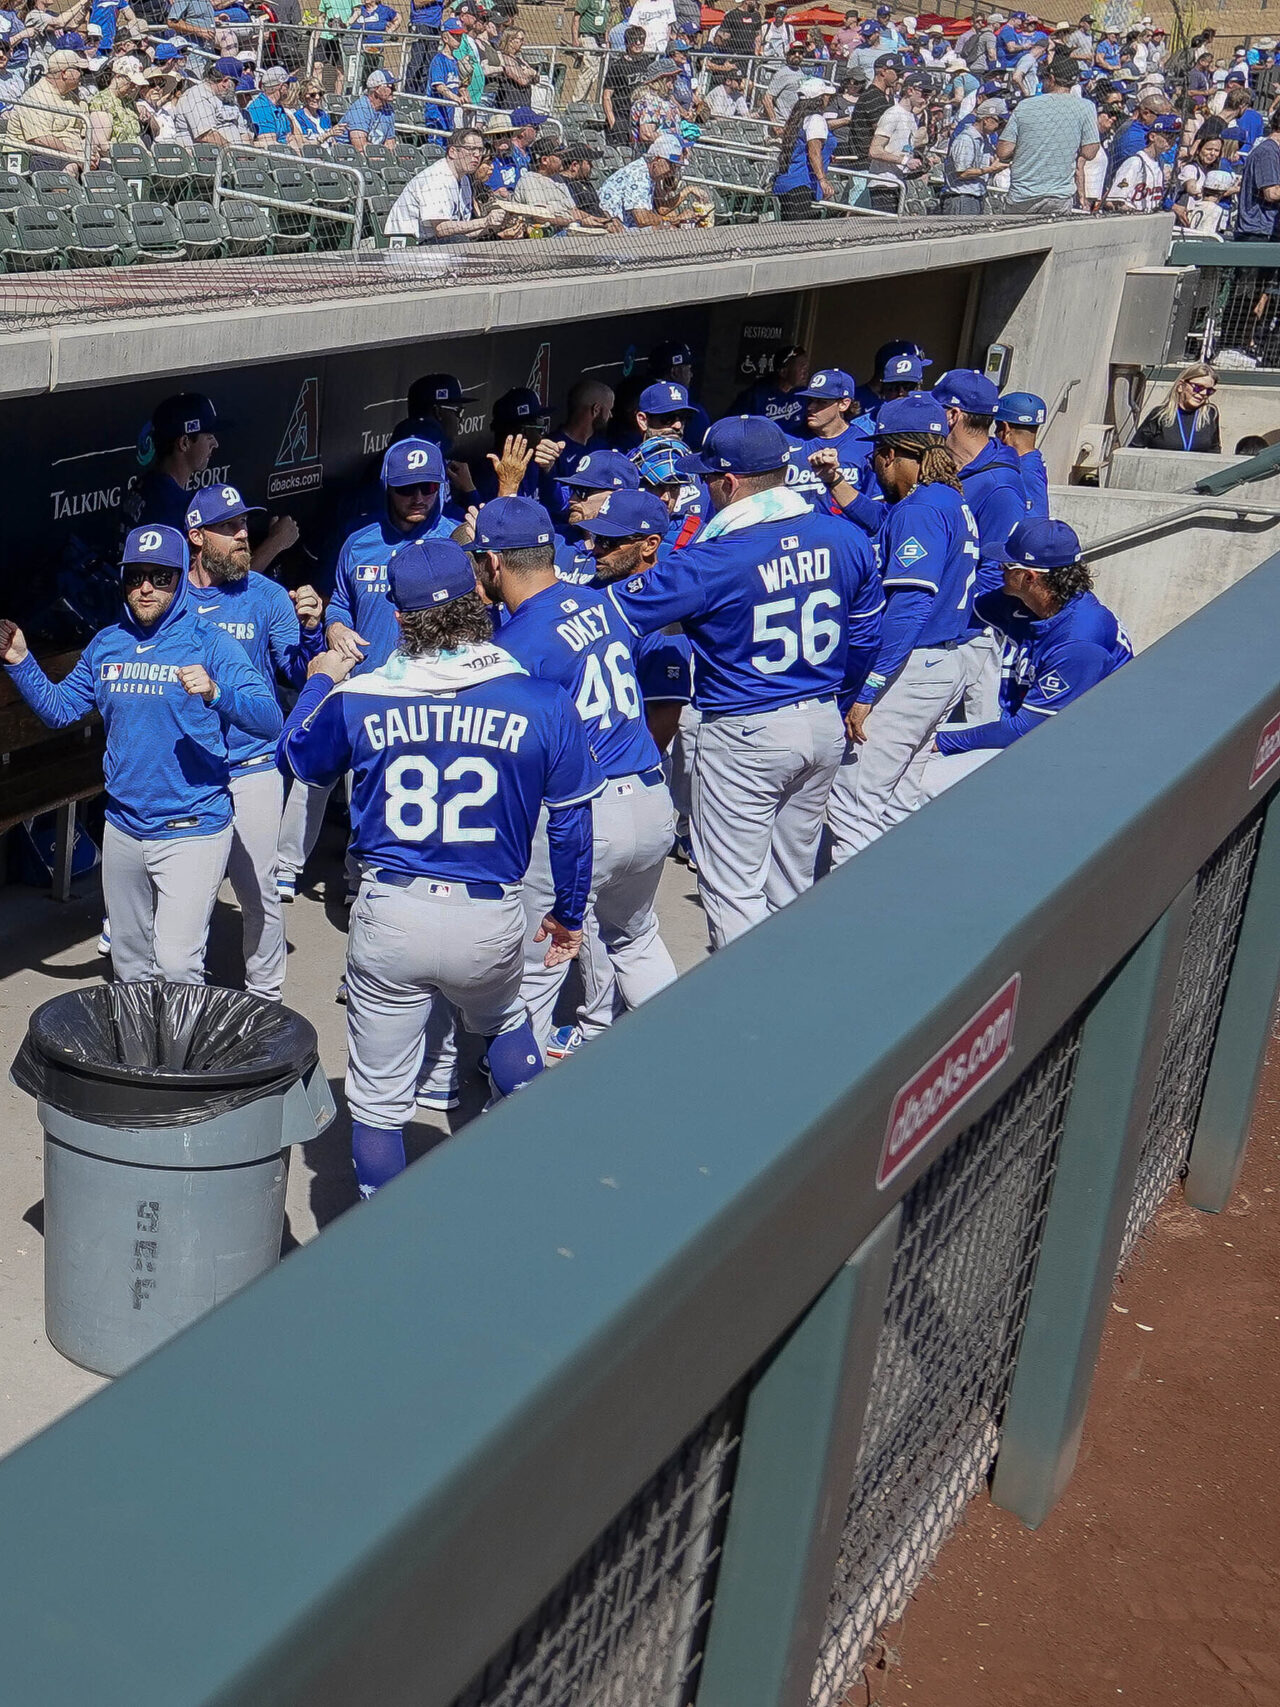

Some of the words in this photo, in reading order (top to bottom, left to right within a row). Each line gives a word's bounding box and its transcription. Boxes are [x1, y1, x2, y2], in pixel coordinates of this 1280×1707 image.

[743, 326, 783, 339] RESTROOM
[810, 374, 827, 388] D
[406, 450, 428, 470] D
[184, 465, 231, 491] ESORT
[270, 472, 320, 492] dbacks.com
[50, 486, 121, 520] TALKING
[222, 487, 241, 506] D
[139, 531, 162, 553] D
[757, 547, 831, 593] WARD
[556, 603, 611, 653] OKEY
[751, 588, 842, 675] 56
[122, 661, 180, 682] DODGER
[110, 682, 164, 696] BASEBALL
[576, 640, 641, 730] 46
[363, 705, 529, 754] GAUTHIER
[384, 754, 499, 844] 82
[888, 1008, 1011, 1156] dbacks.com
